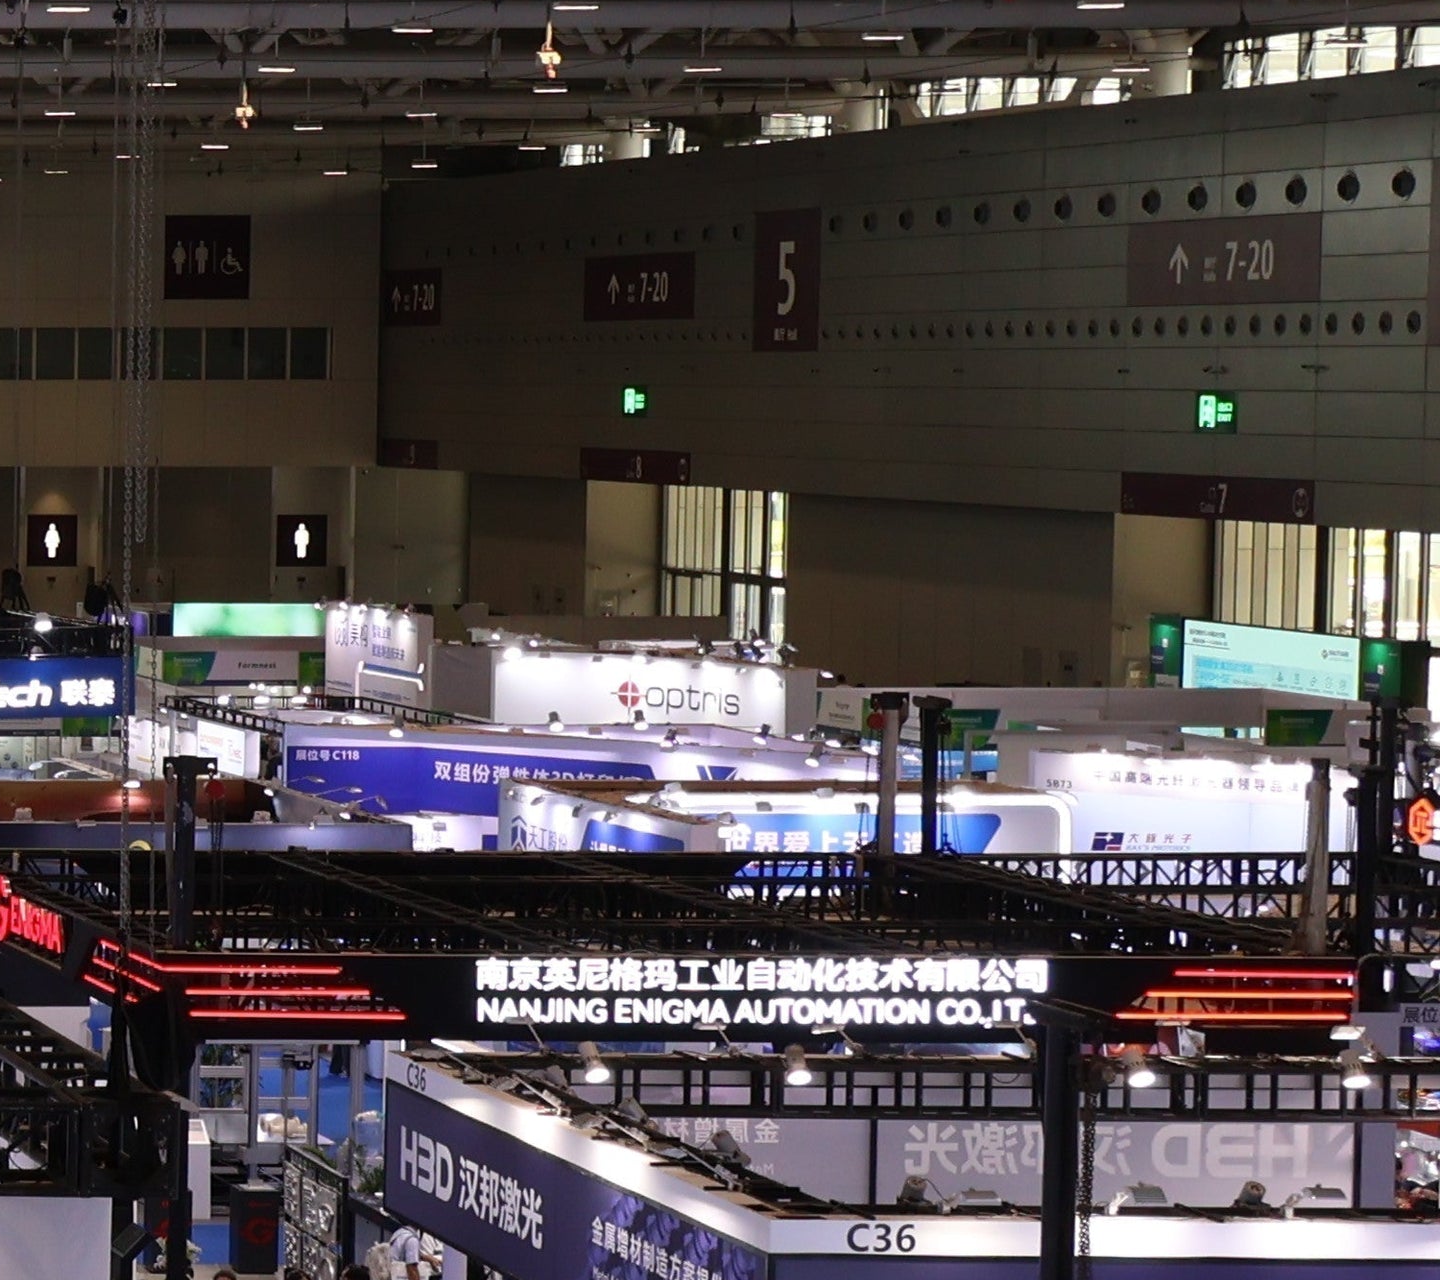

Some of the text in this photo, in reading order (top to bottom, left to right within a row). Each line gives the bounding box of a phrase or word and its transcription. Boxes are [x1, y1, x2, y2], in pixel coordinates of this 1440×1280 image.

[1225, 239, 1274, 281] 7-20
[639, 272, 669, 303] 7-20
[777, 240, 796, 316] 5
[1218, 482, 1228, 513] 7
[60, 678, 115, 707] 联泰
[332, 750, 361, 762] C118
[10, 896, 63, 954] ENIGMA
[475, 957, 1049, 993] 南京英尼格玛工业自动化技术有限公司
[476, 998, 929, 1025] NANJING ENIGMA AUTOMATION
[406, 1063, 427, 1092] C36
[458, 1156, 544, 1250] 汉邦激光
[846, 1223, 917, 1253] C36
